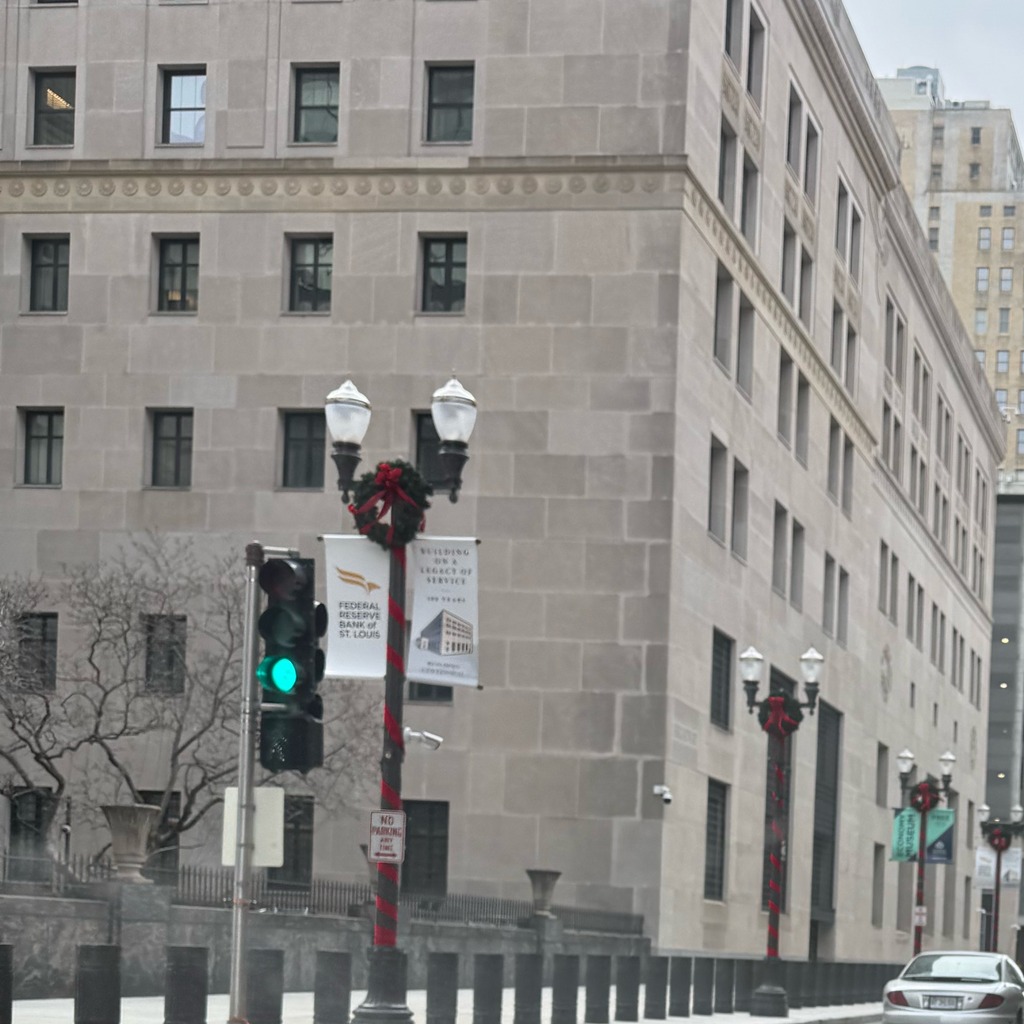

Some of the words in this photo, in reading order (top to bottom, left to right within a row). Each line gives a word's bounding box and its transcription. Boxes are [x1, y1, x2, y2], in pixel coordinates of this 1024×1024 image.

[339, 601, 380, 610] FEDERAL
[339, 611, 380, 620] RESERVE
[339, 621, 365, 629] BANK
[367, 621, 377, 630] of
[339, 630, 351, 639] ST.
[353, 630, 381, 639] LOUIS
[381, 815, 394, 826] NO
[371, 826, 402, 838] PARKING
[905, 814, 915, 857] MUSEUM
